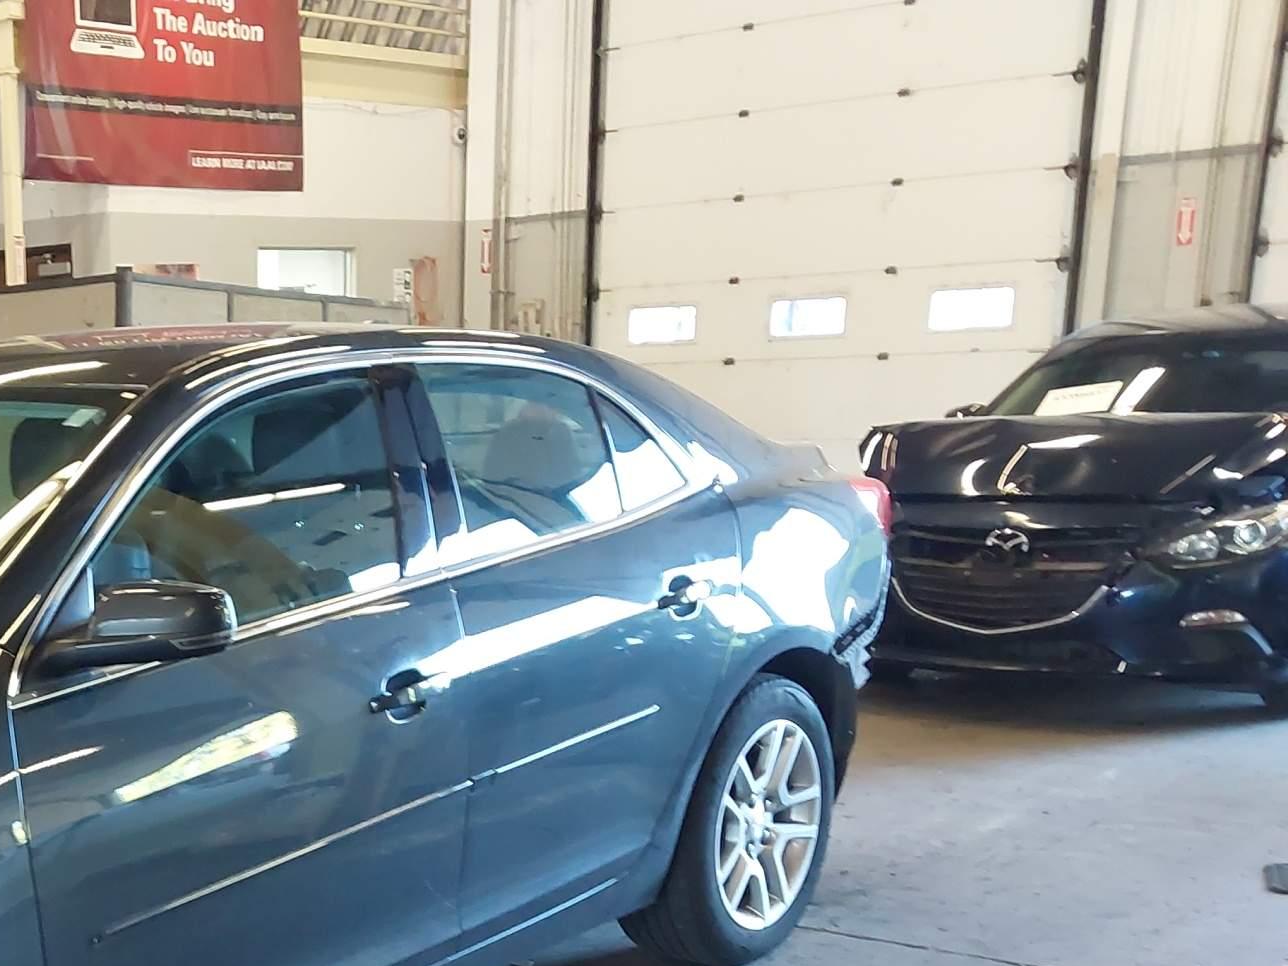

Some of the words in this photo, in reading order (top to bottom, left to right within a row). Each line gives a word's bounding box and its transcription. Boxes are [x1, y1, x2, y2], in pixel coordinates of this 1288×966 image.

[152, 6, 188, 33] The
[192, 12, 264, 42] Auction
[152, 38, 177, 63] To
[179, 40, 215, 67] You
